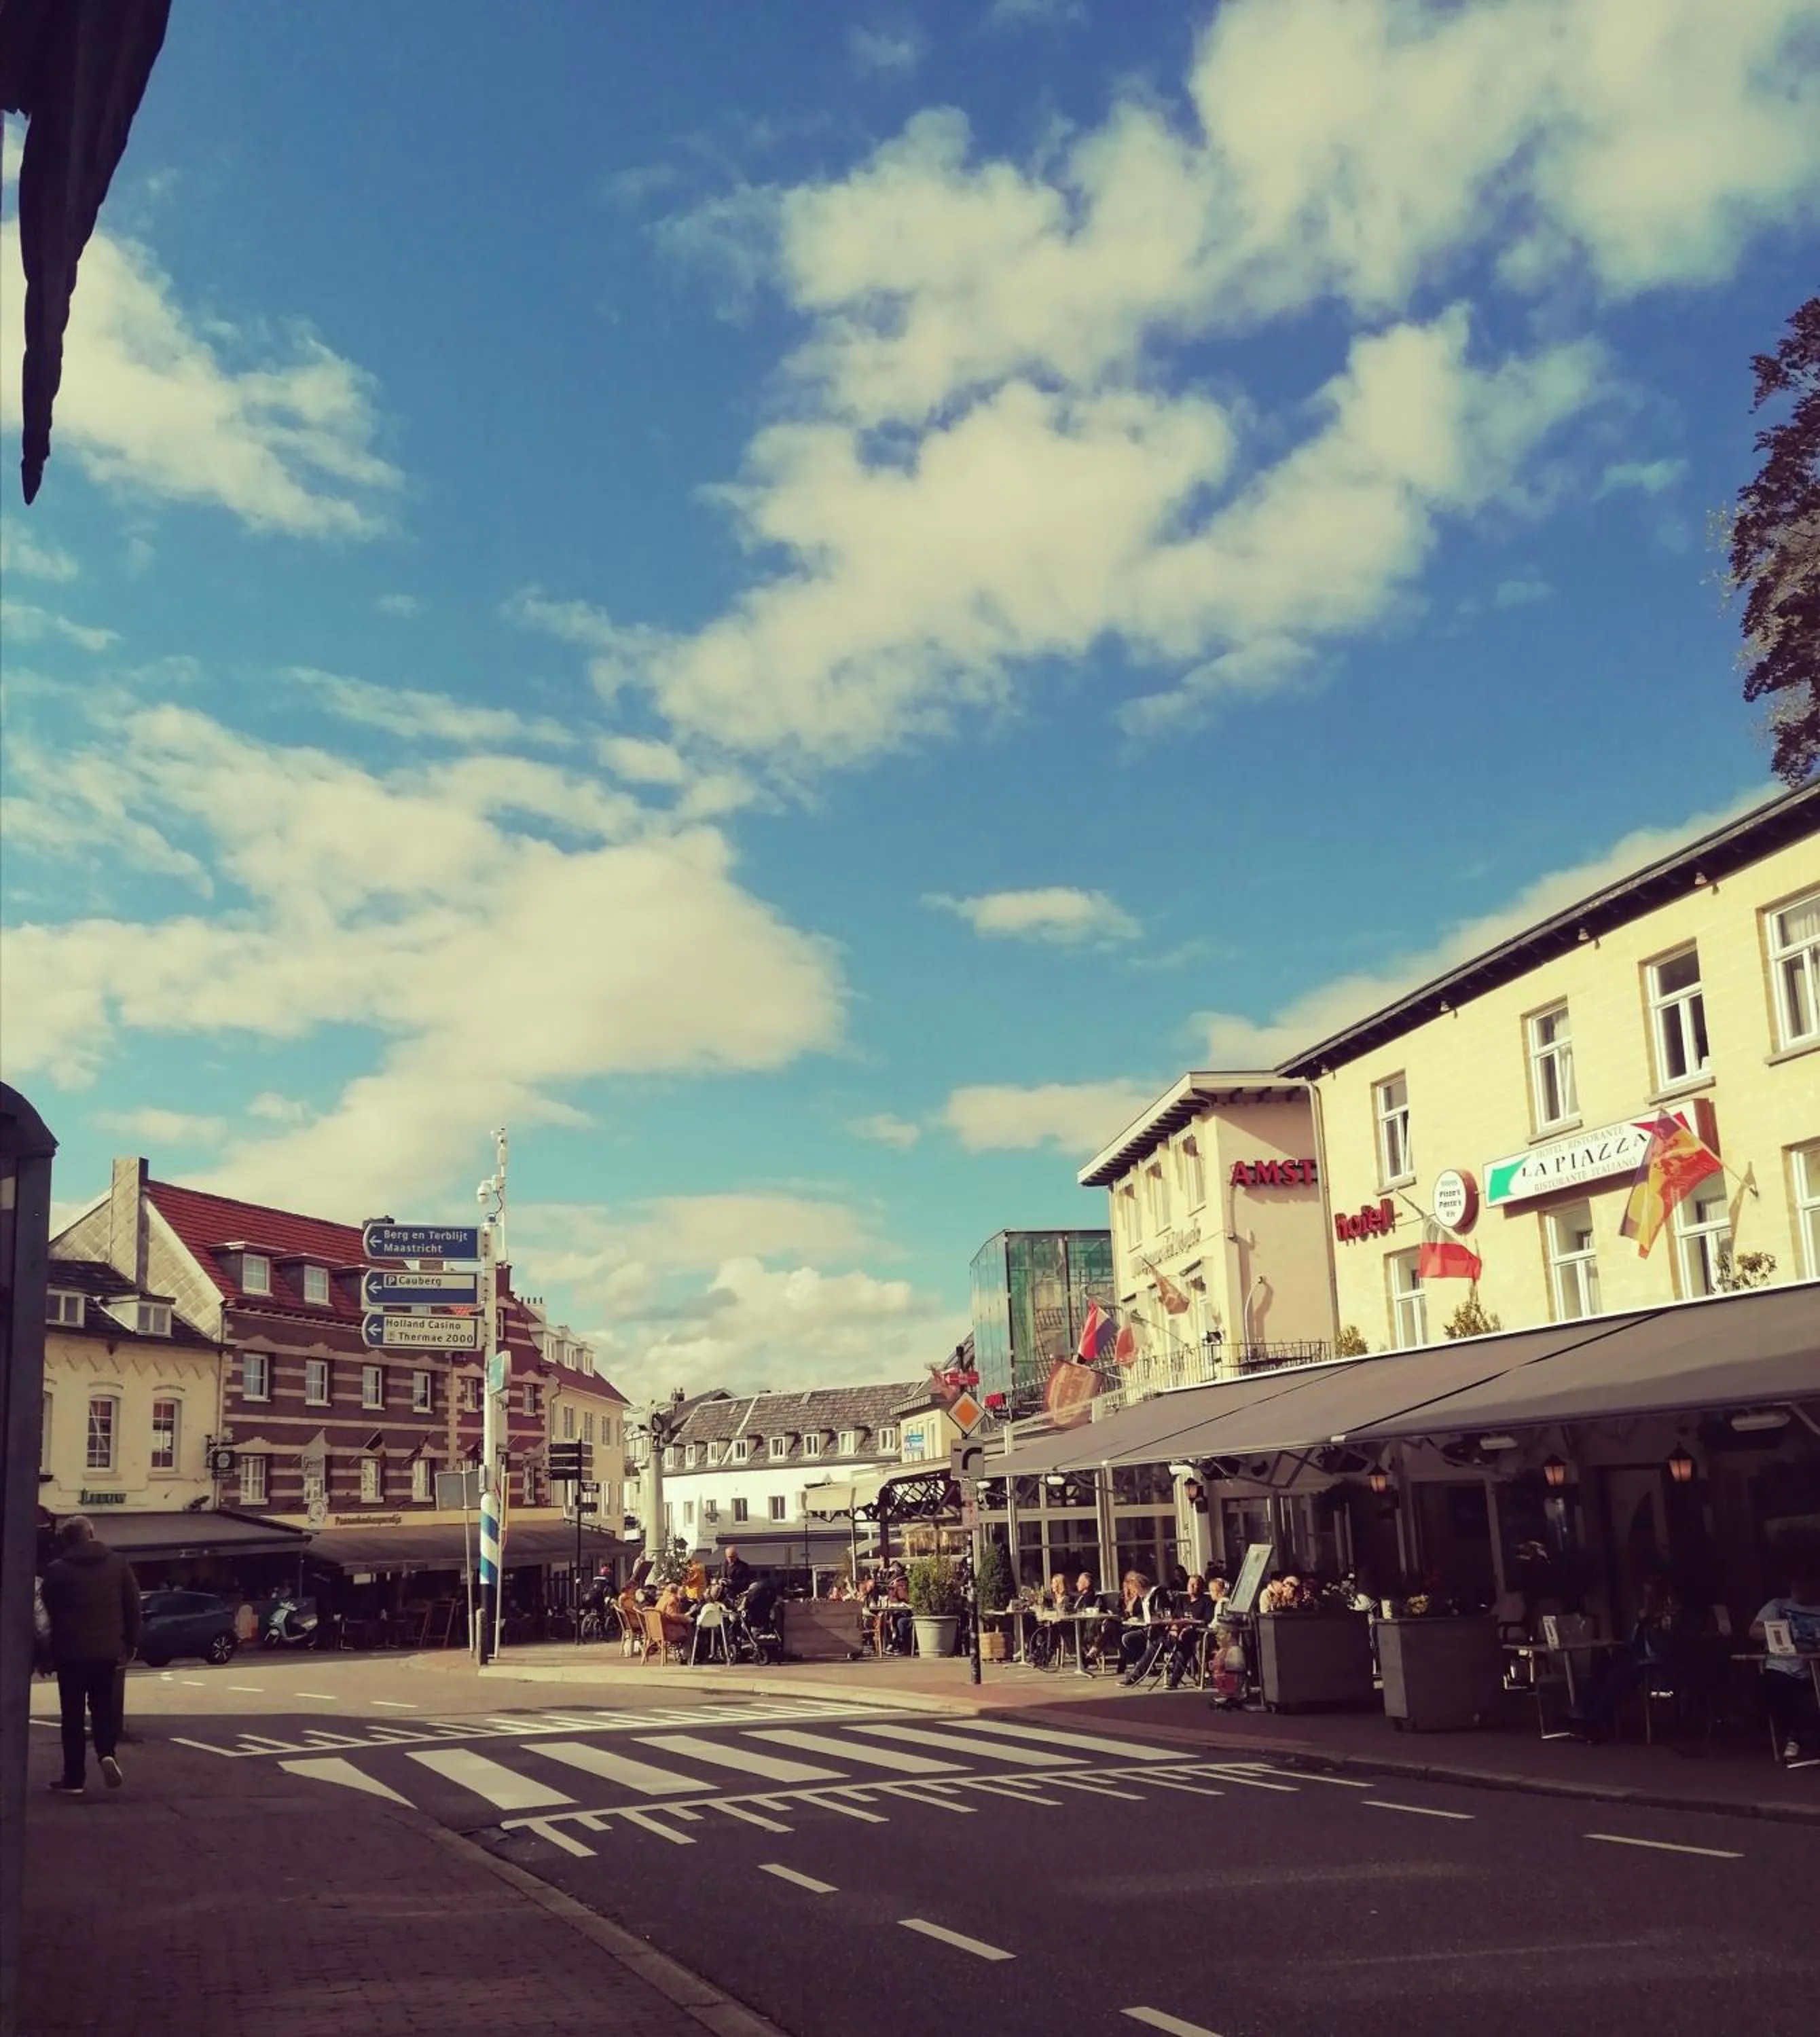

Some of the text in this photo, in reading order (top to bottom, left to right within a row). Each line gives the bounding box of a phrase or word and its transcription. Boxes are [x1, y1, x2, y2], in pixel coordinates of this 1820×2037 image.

[1522, 1133, 1648, 1177] LA PIAZZA
[383, 1230, 468, 1242] Berg en Terblijt
[383, 1243, 443, 1253] Maastricht
[398, 1276, 442, 1287] Cauberg
[385, 1317, 462, 1330] Holland Casino
[398, 1332, 473, 1343] Thermae 2000
